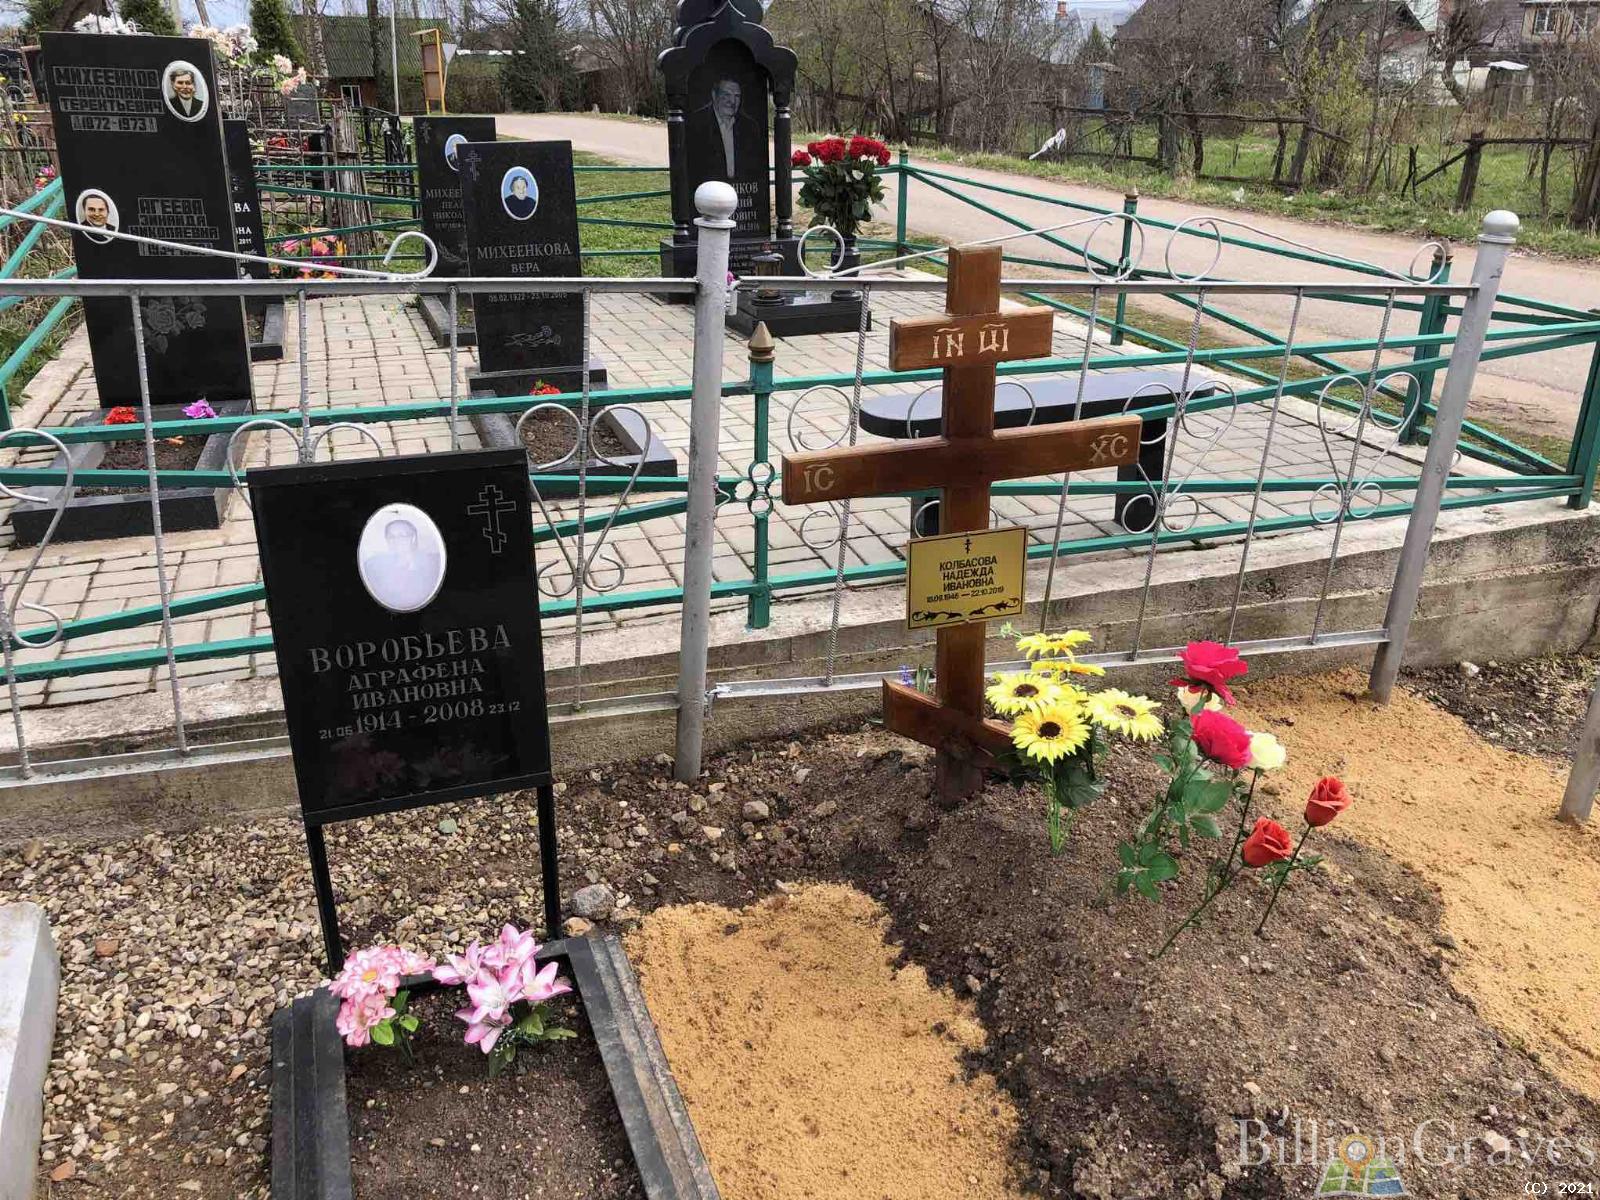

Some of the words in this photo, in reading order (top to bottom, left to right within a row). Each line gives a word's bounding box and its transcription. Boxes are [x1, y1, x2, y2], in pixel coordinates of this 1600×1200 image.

[139, 199, 203, 214] АГЕЕВА
[476, 242, 573, 260] МИХЕЕНКОВА
[511, 262, 540, 273] ВЕРА
[940, 555, 998, 572] КОЛБАСОВА
[942, 565, 995, 581] НАДЕЖДА
[942, 577, 995, 593] ИВАНОВНА
[309, 624, 512, 674] ВОРОБЬЕВА
[347, 658, 486, 692] АГРАФЕНА
[351, 677, 484, 711] ИВАНОВНА
[423, 699, 485, 724] 2008
